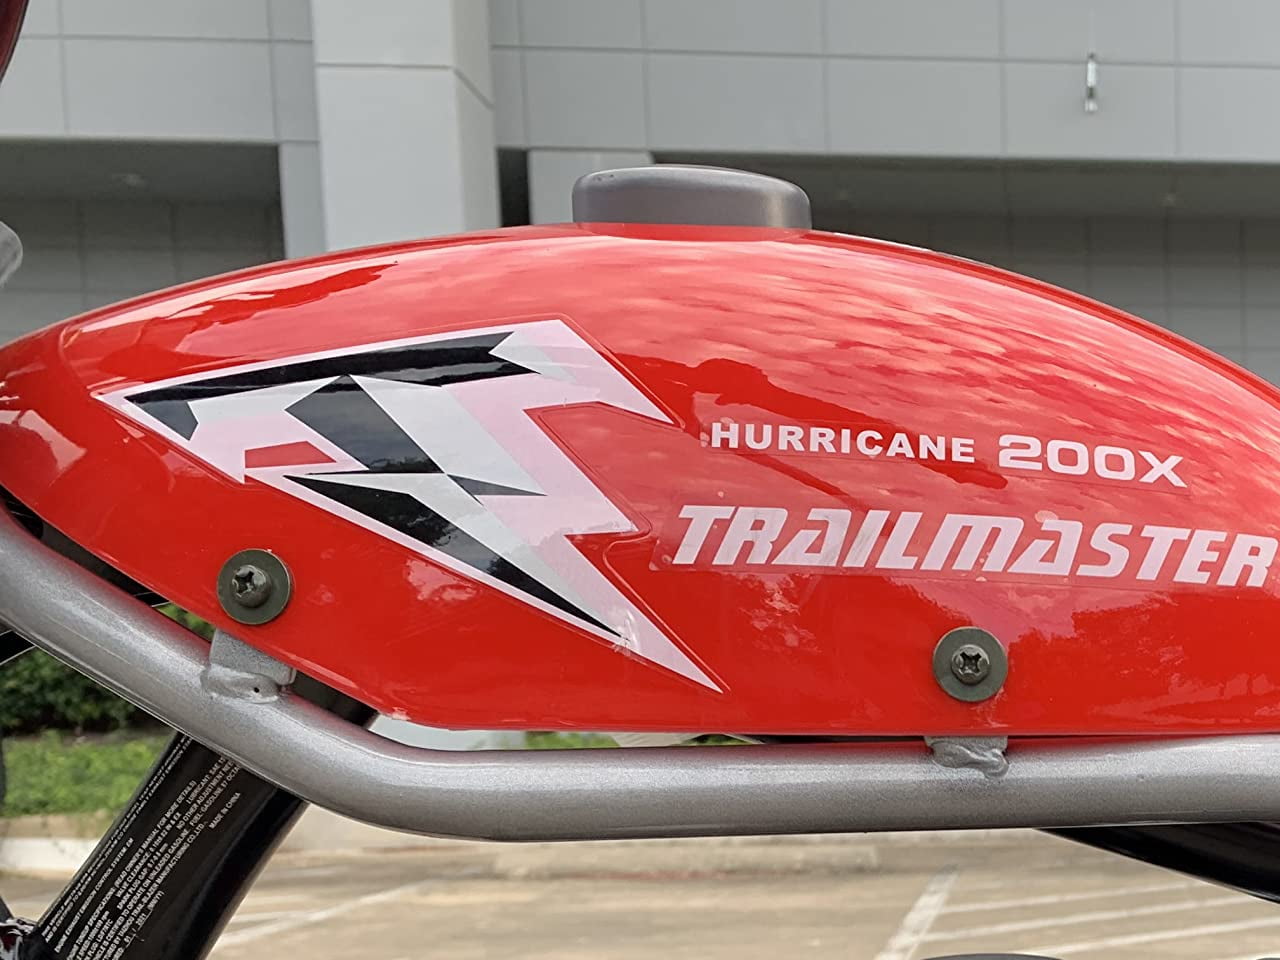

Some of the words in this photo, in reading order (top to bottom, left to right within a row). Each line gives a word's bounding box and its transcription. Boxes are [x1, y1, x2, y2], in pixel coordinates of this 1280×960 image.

[711, 423, 976, 463] HURRICANE
[999, 435, 1188, 488] 200X
[672, 505, 1279, 587] TRAILMASTER
